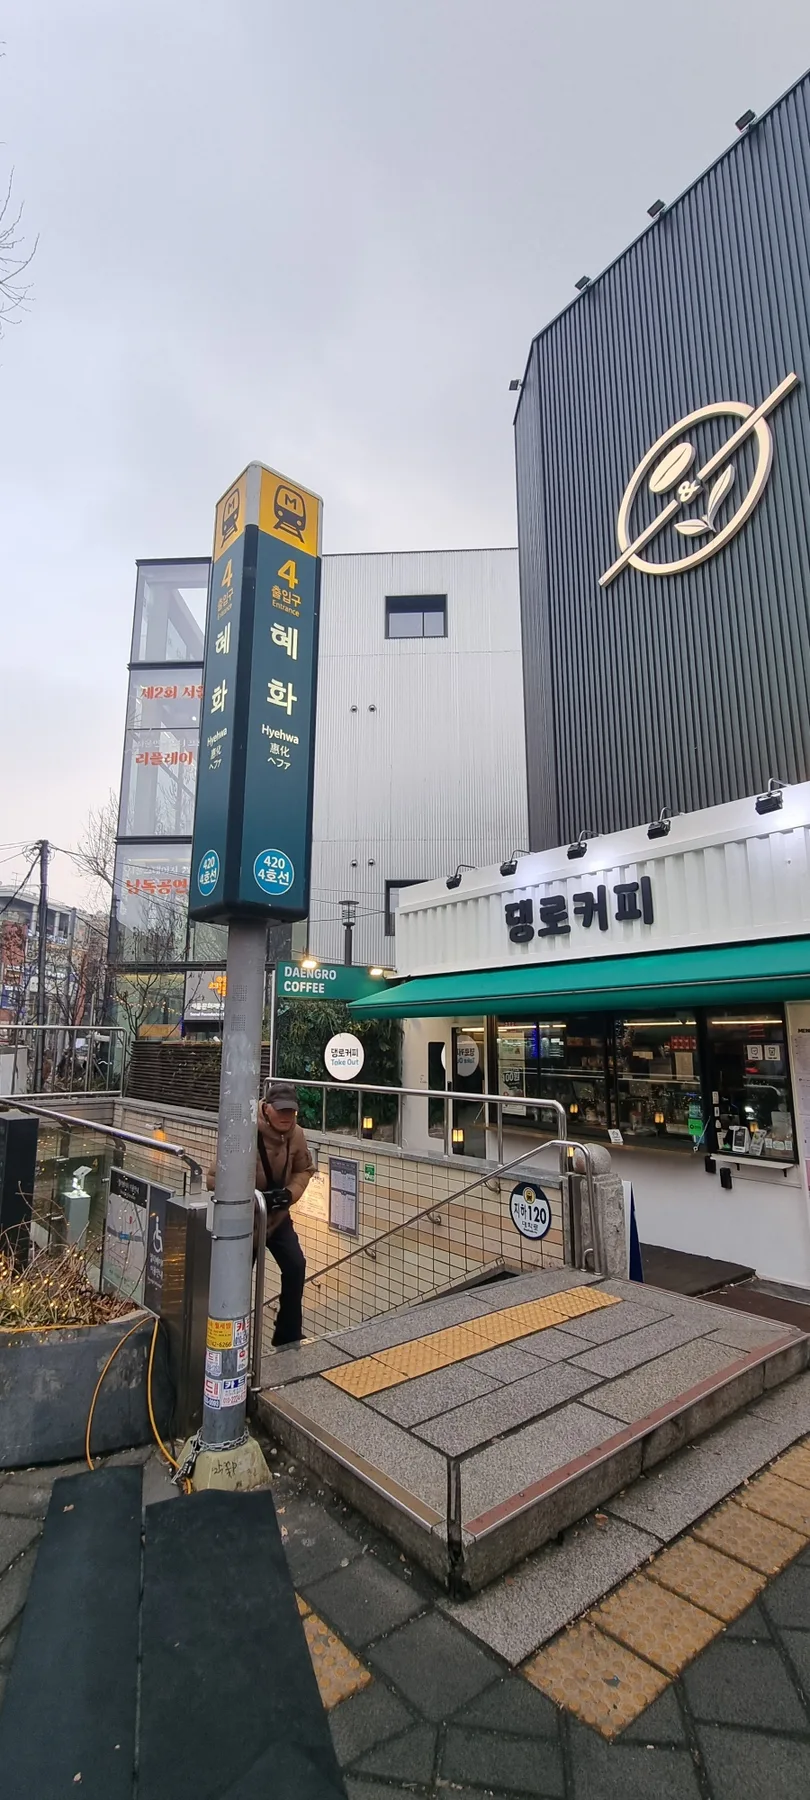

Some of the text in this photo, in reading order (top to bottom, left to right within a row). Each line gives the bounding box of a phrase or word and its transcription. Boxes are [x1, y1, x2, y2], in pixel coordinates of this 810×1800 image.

[221, 559, 233, 588] 4
[277, 559, 299, 589] 4
[271, 585, 302, 607] 출입구
[272, 599, 300, 617] Entrance
[141, 684, 178, 700] 제2회
[207, 727, 228, 747] Hyehwa
[262, 724, 300, 745] Hyehwa
[136, 751, 193, 766] 리플레이
[267, 757, 291, 770] ヘファ
[203, 856, 215, 869] 420
[263, 856, 285, 869] 420
[200, 868, 217, 885] 4호선
[257, 868, 290, 886] 4호선
[505, 876, 654, 944] 댕로커피
[284, 966, 337, 980] DAENGRO
[284, 980, 325, 994] COFFEE
[330, 1047, 359, 1058] 댕로커피
[331, 1058, 359, 1066] Take Out
